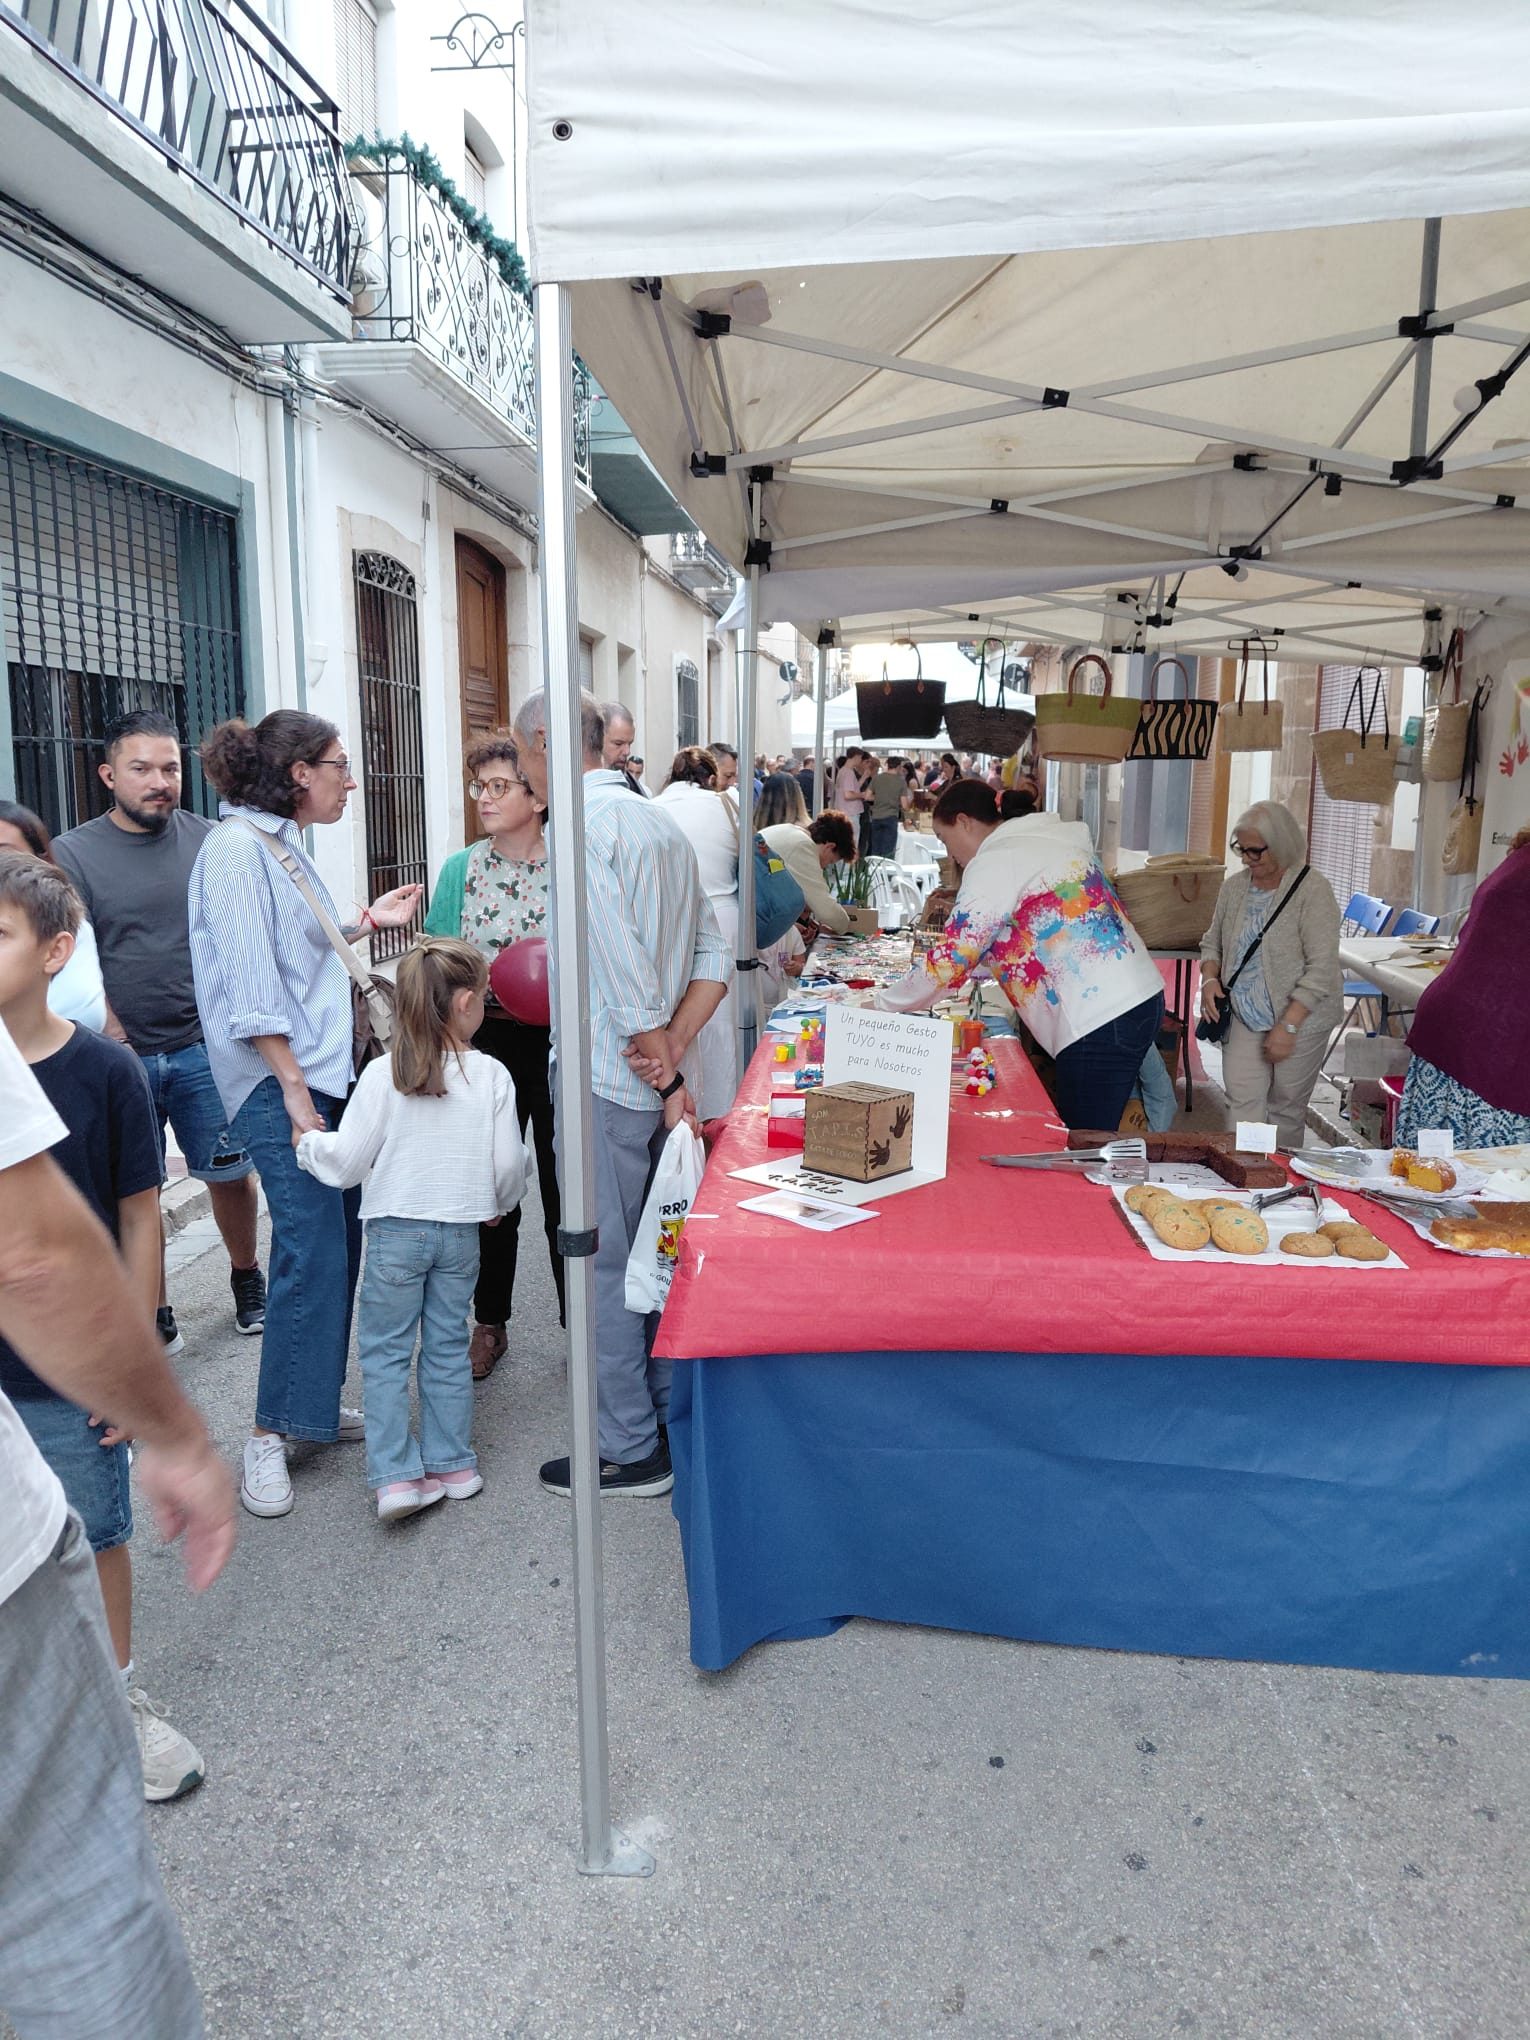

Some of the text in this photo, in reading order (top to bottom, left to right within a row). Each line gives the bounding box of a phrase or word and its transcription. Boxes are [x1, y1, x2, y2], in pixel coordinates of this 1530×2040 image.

[841, 1012, 937, 1039] Un pequeño Gesto
[846, 1032, 930, 1058] TUYO es mucho
[847, 1055, 923, 1076] para Nosotros
